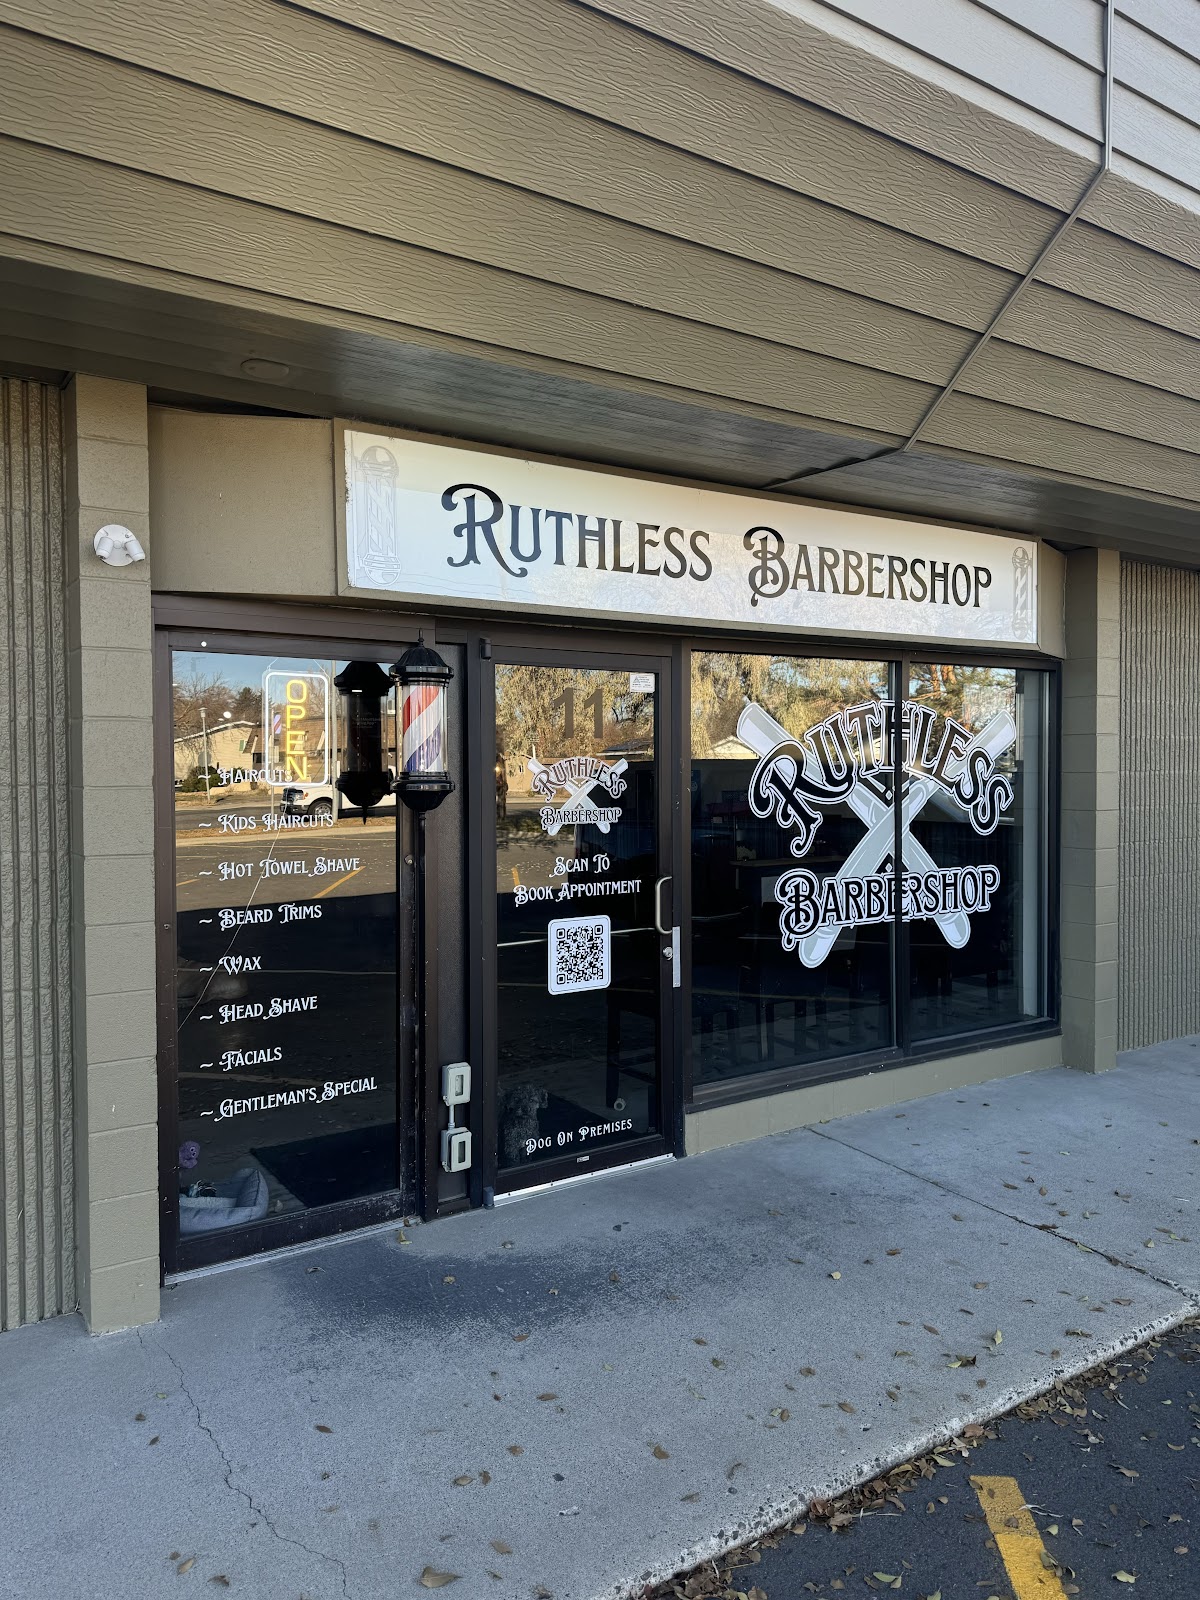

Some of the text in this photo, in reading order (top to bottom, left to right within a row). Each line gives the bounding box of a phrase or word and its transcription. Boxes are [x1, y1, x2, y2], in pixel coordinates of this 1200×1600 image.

[440, 483, 992, 608] RUTHLESS BARBERSHOP
[553, 687, 604, 739] 11
[286, 679, 307, 781] OPEN
[217, 812, 334, 834] KIDS HAIRCUTS
[539, 805, 622, 830] BARBERSHOP
[217, 856, 361, 882] HOT TOWEL SHAVE
[549, 853, 610, 878] SCAN TO
[512, 879, 642, 907] BOOK APPOINTMENT
[218, 903, 323, 931] BEARD TRIMS
[218, 955, 262, 976] WAX
[218, 996, 318, 1024] HEAD SHAVE
[218, 1046, 283, 1072] FACIALS
[316, 1077, 378, 1104] SPECIAL
[525, 1118, 633, 1156] DOG ON PREMISES
